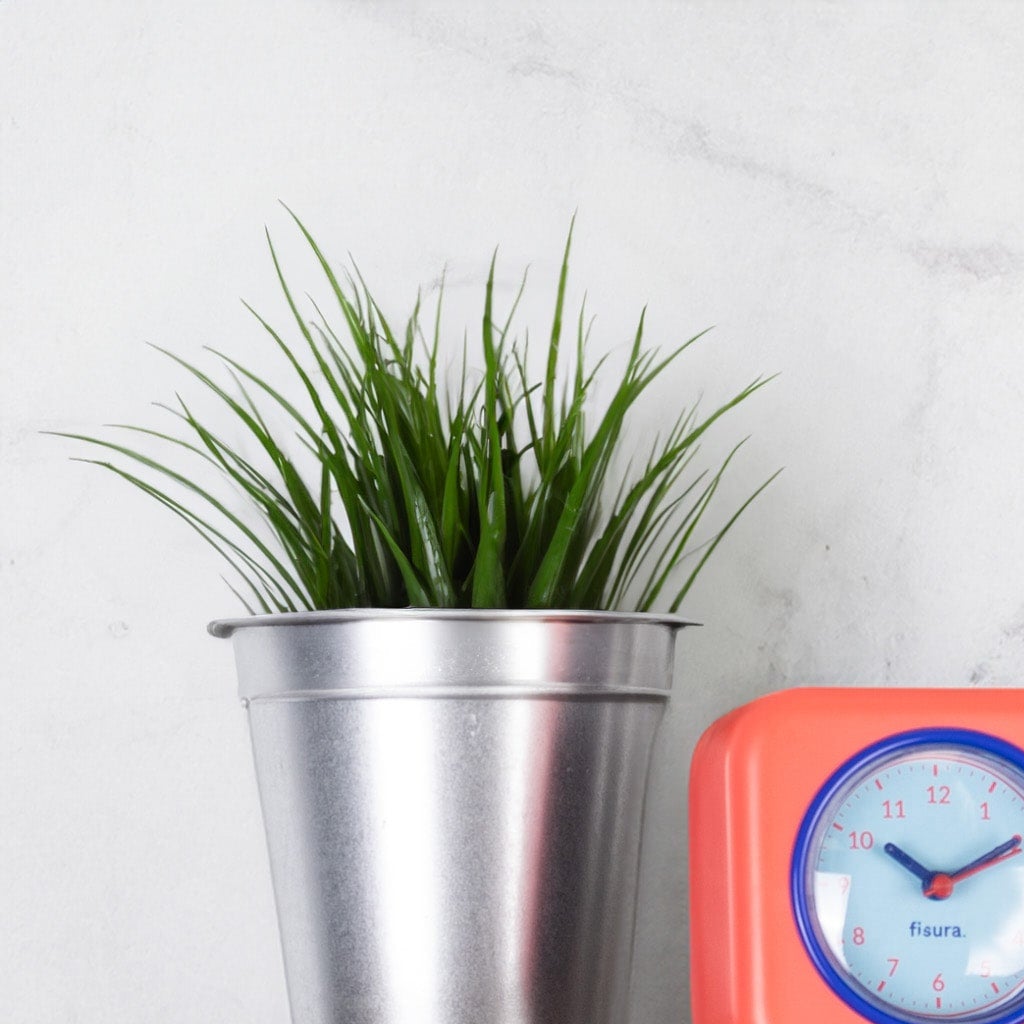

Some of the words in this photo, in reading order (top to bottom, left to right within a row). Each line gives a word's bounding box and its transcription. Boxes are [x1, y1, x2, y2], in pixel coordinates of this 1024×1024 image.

[927, 786, 951, 804] 12
[882, 800, 906, 818] 11
[980, 802, 990, 820] 1
[848, 832, 874, 850] 10
[852, 927, 865, 945] 8
[909, 921, 966, 938] fisura.
[887, 959, 899, 977] 7
[932, 973, 945, 991] 6
